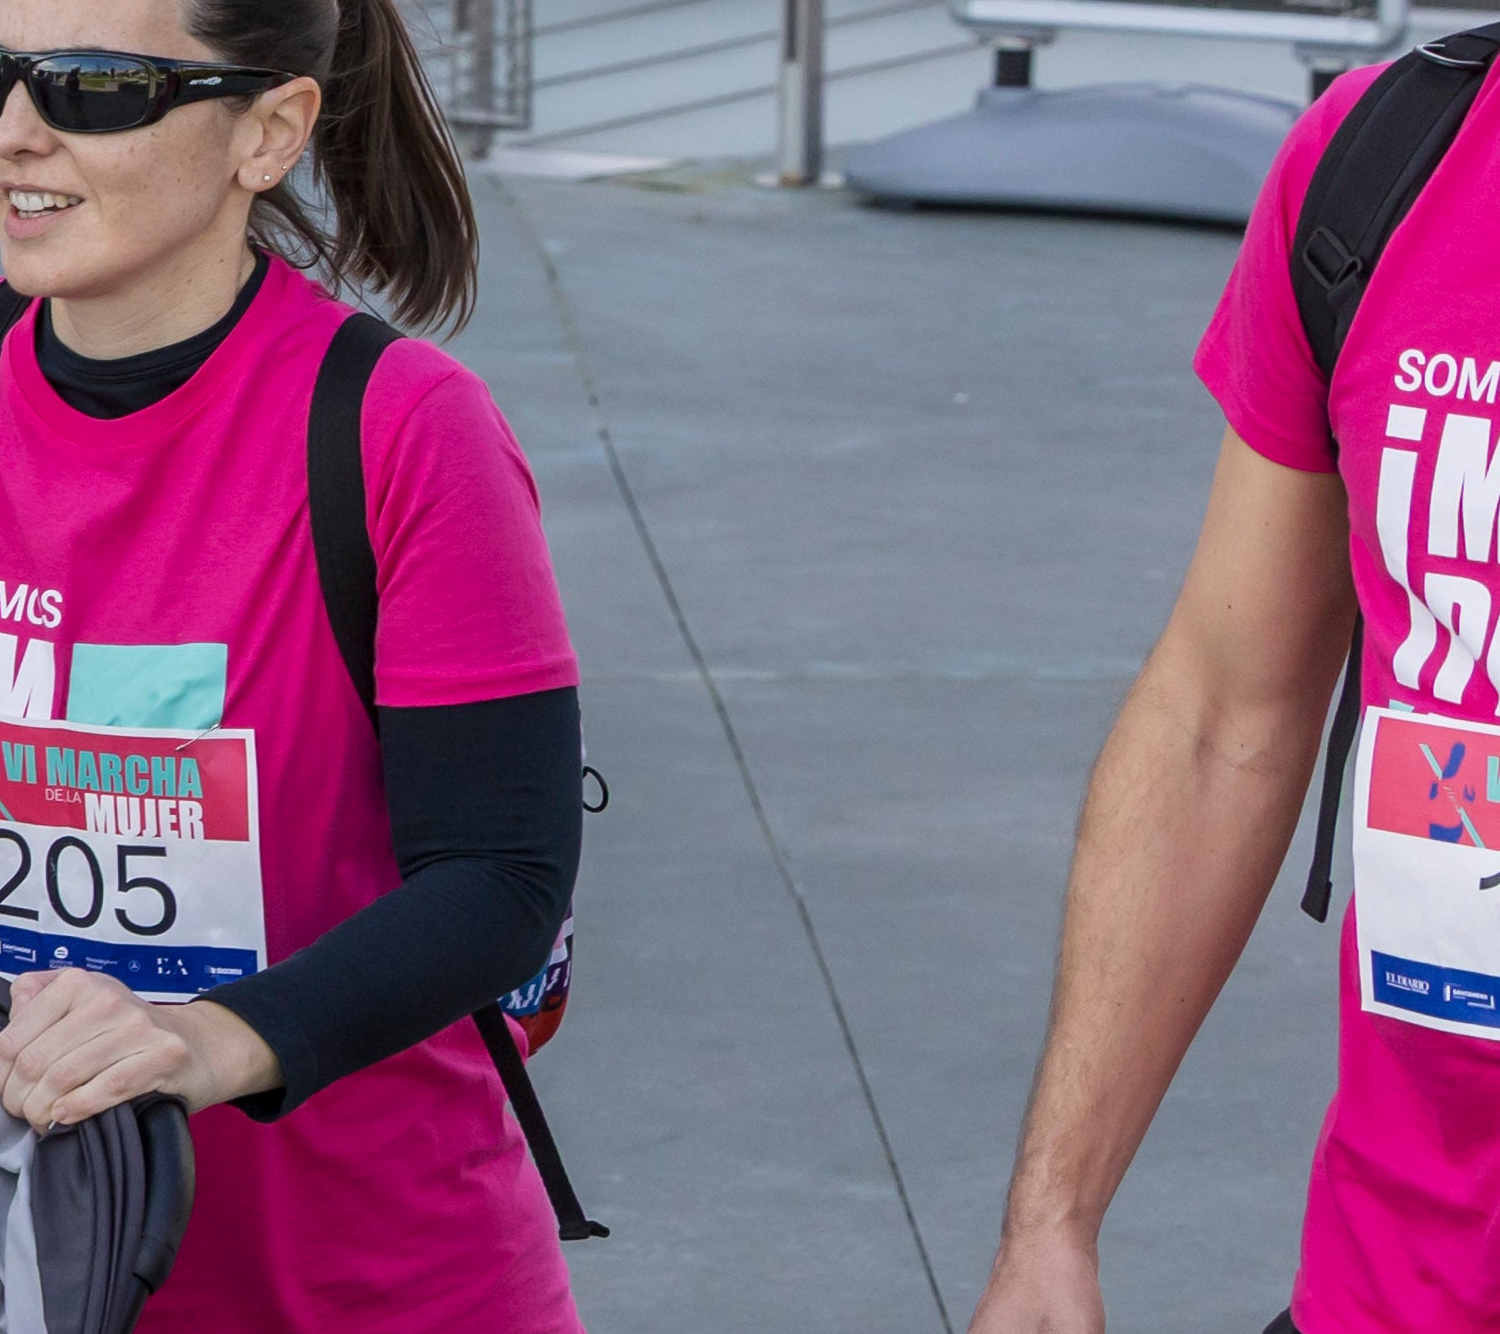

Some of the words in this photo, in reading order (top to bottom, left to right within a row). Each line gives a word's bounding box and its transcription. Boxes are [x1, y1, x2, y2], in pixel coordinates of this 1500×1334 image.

[2, 741, 37, 784] VI
[45, 746, 203, 798] MARCHA
[45, 788, 63, 802] DE
[66, 790, 82, 804] LA
[84, 793, 204, 840] MUJER
